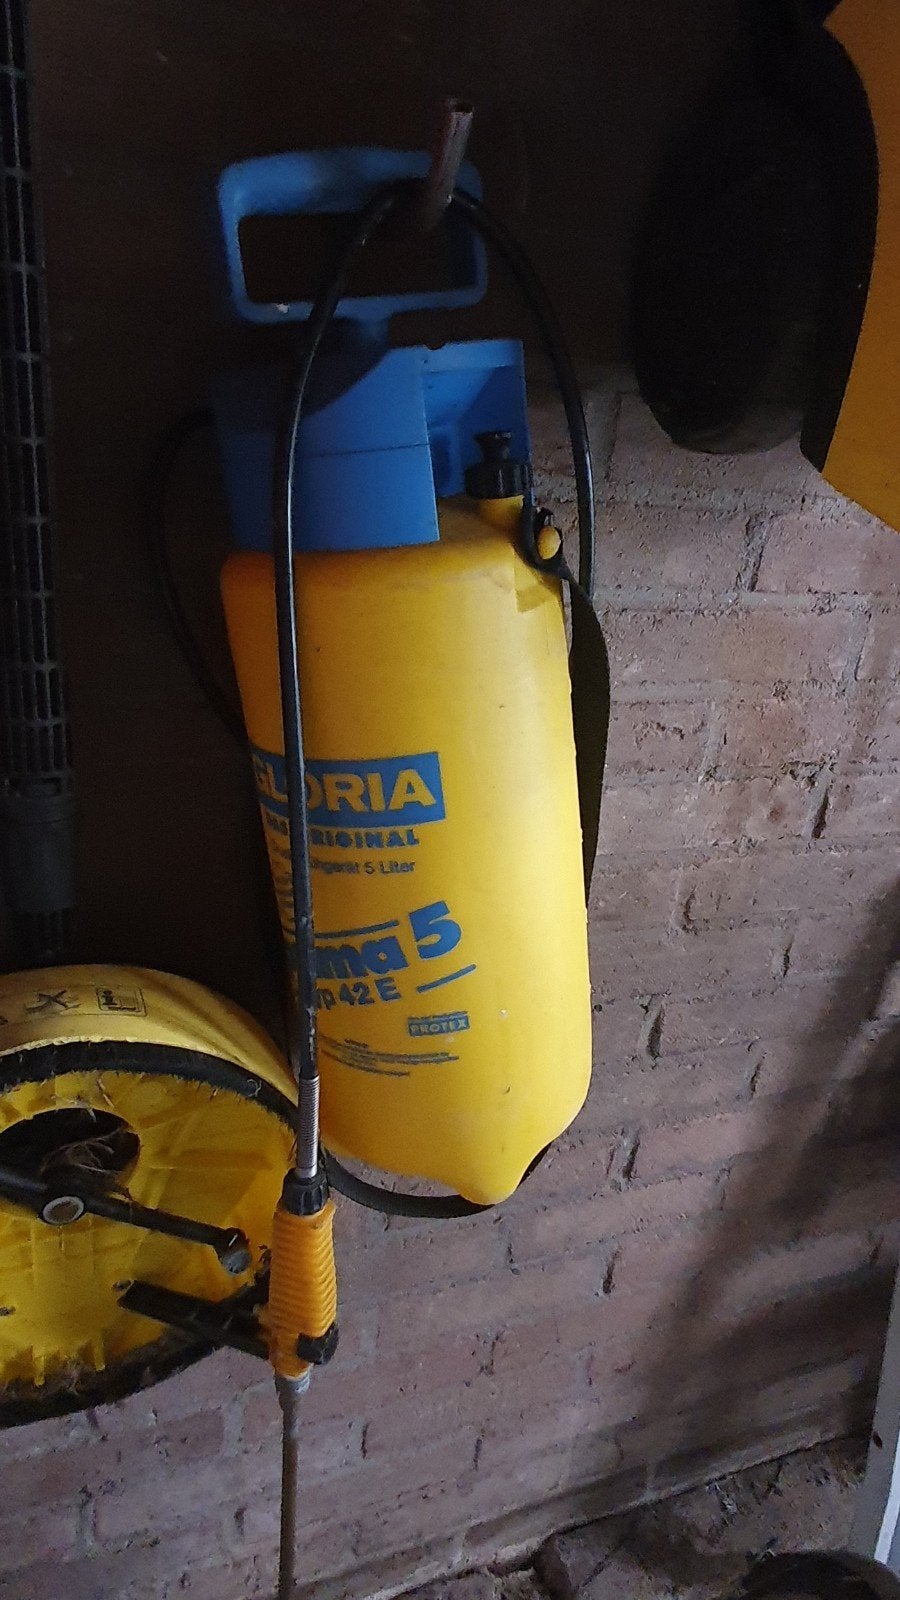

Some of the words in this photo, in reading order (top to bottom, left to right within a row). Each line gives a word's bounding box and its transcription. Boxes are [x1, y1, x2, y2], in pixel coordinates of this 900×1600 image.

[310, 829, 419, 849] RIGINAL
[364, 861, 375, 875] 5
[379, 861, 415, 874] Liter
[409, 900, 462, 960] 5
[339, 982, 375, 1006] 42
[374, 977, 401, 1002] E
[409, 1018, 468, 1034] PROTEX
